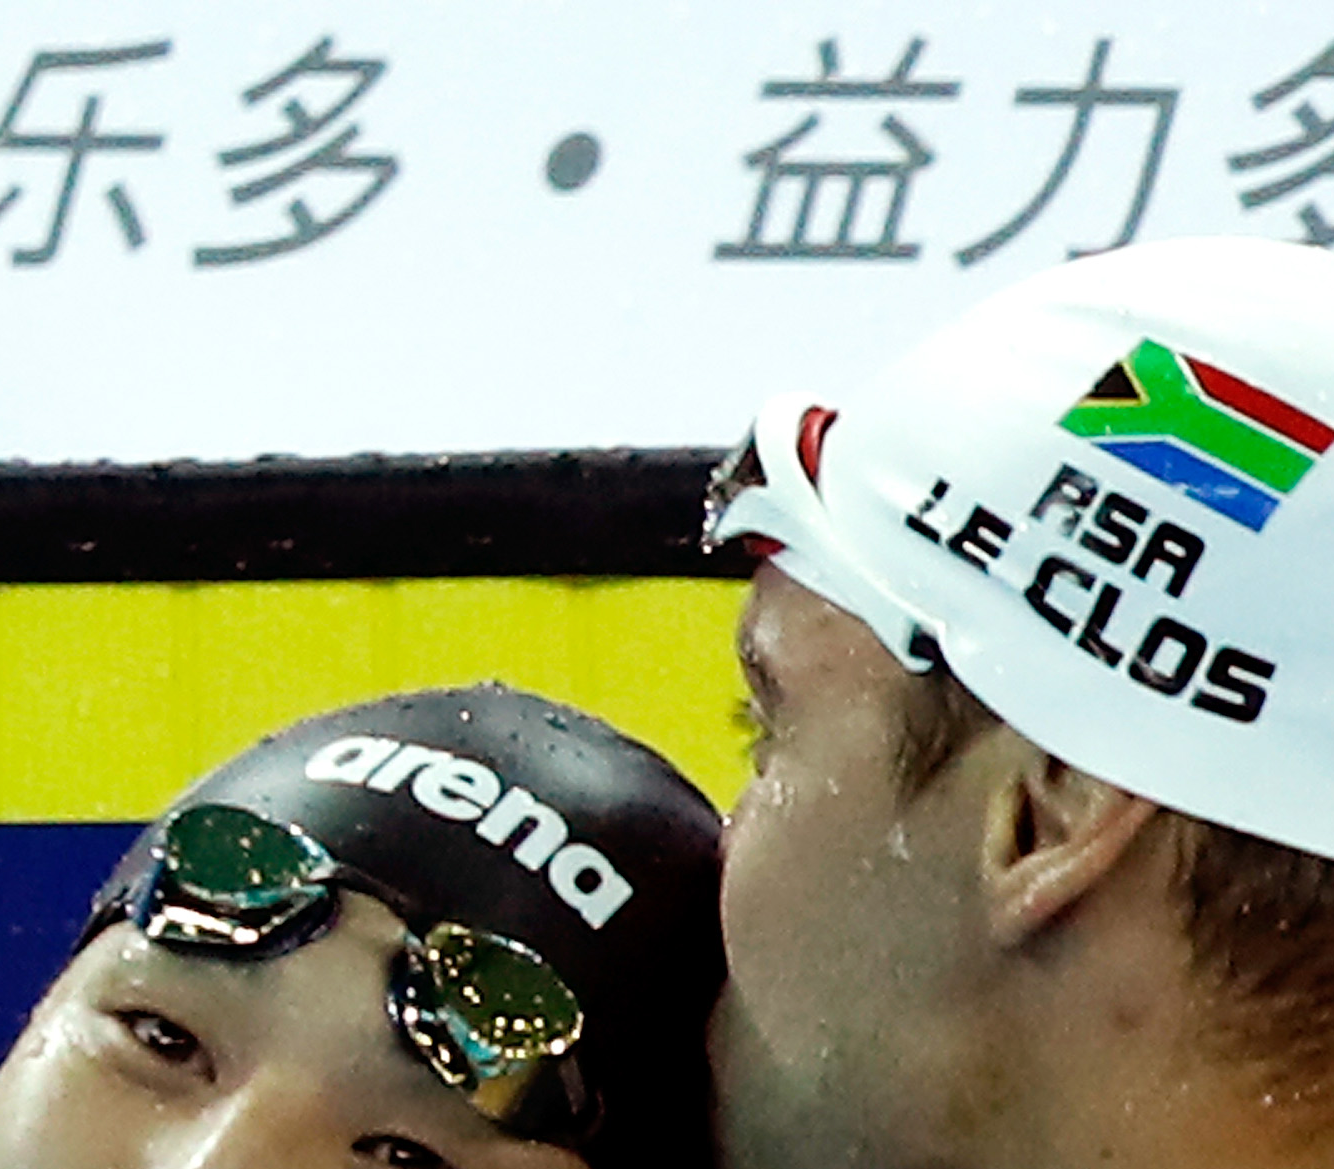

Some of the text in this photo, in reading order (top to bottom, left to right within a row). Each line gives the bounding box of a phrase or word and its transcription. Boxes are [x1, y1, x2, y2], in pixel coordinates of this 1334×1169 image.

[905, 477, 1277, 724] LE CLOS
[1028, 462, 1206, 600] RSA
[305, 735, 634, 930] arena
